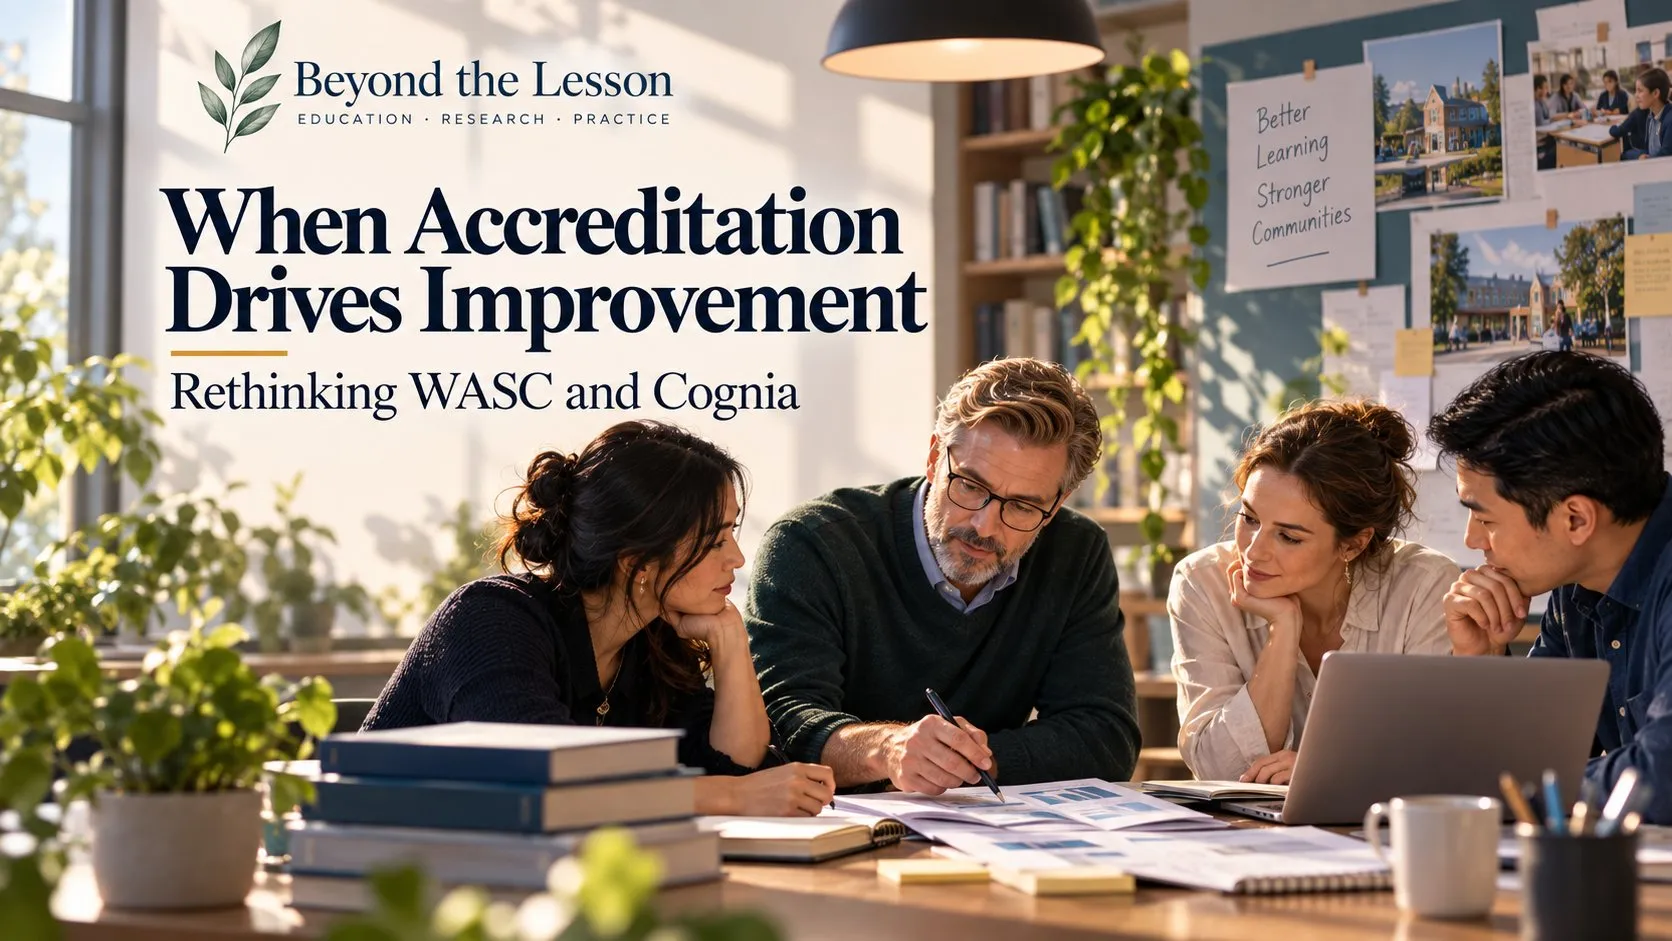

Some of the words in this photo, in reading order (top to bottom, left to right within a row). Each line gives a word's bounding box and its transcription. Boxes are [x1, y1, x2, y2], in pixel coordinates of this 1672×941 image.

[1256, 101, 1312, 134] Better
[1256, 135, 1329, 170] Learning
[1256, 175, 1331, 208] Stronger
[1252, 206, 1353, 246] Communities
